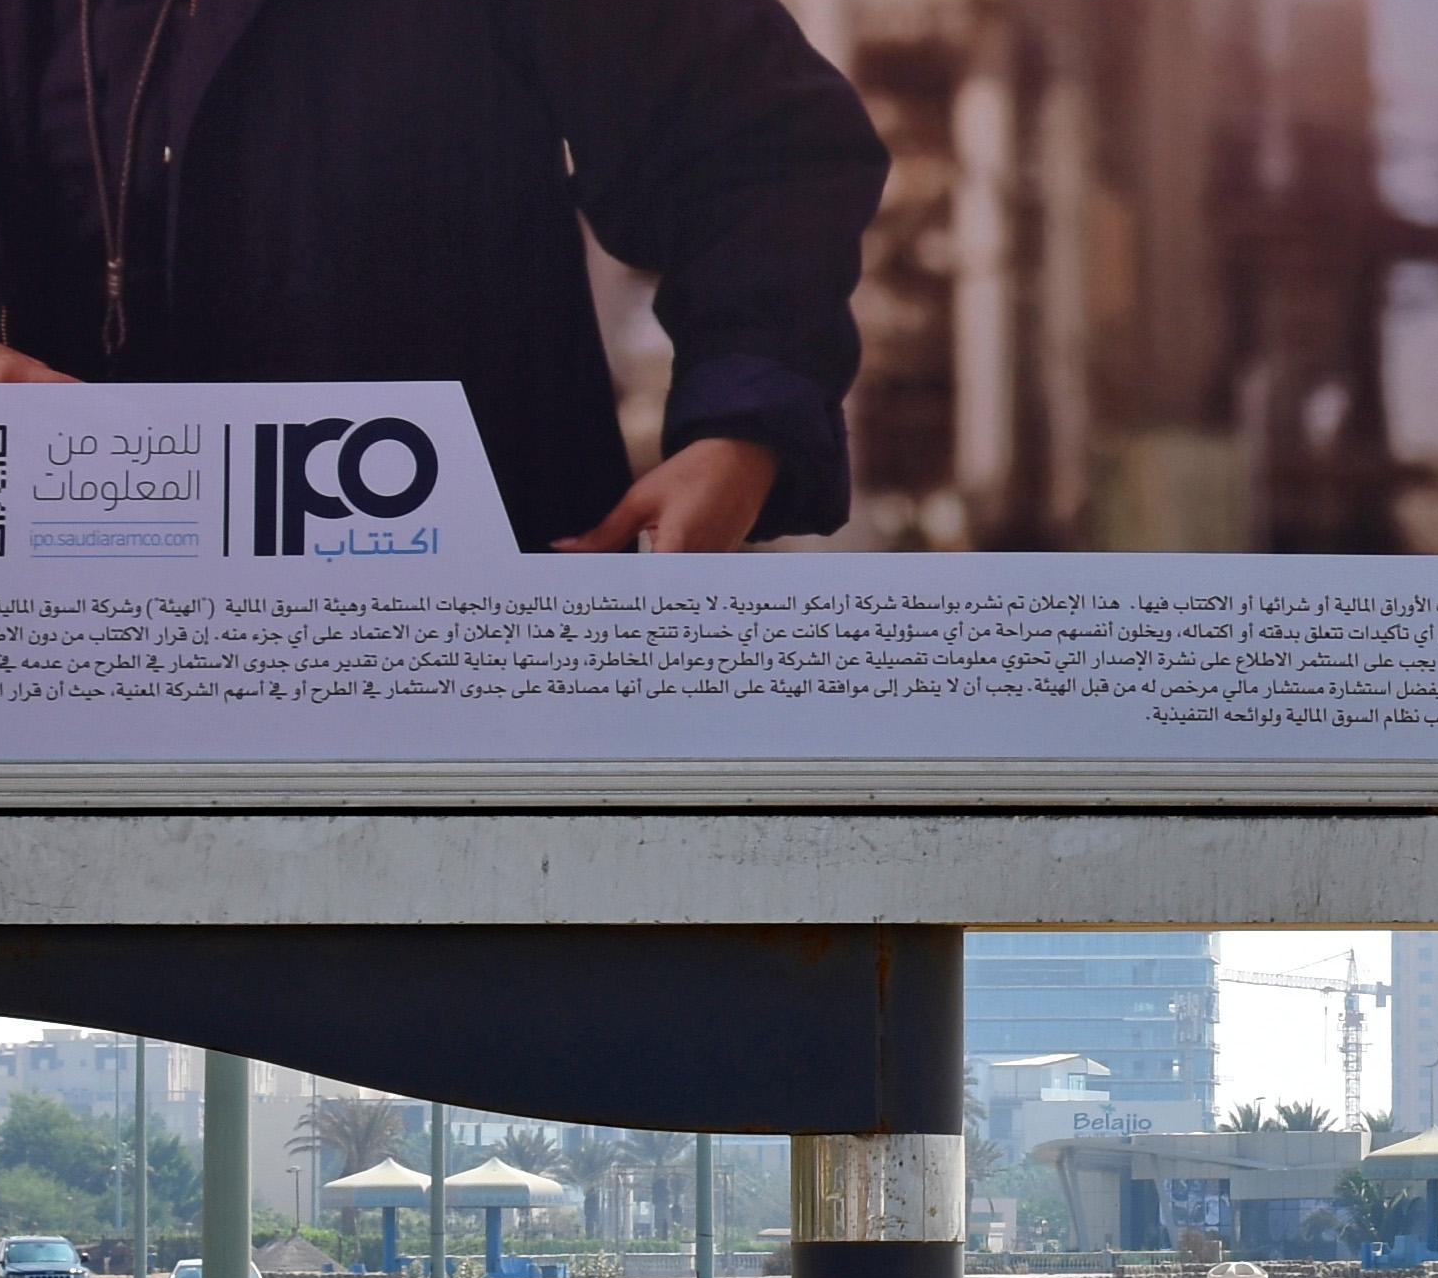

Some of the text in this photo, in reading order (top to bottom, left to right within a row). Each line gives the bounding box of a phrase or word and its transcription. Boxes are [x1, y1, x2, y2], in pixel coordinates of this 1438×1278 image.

[48, 423, 201, 466] للمزيد من
[33, 469, 200, 512] المعلومات
[29, 530, 200, 548] ipo.saudiaramco.com
[314, 527, 438, 563] اكتتاب
[38, 598, 87, 619] السوق
[90, 598, 143, 619] وشركة
[225, 597, 267, 618] المالية
[270, 597, 319, 619] السوق
[323, 597, 367, 618] وهيئة
[371, 596, 431, 613] المستلمة
[435, 595, 502, 616] والجهات
[504, 595, 558, 616] الماليون
[562, 595, 647, 616] المستشارون
[650, 595, 701, 616] يتحمل
[705, 594, 719, 611] لا
[722, 595, 797, 616] السعودية.
[800, 593, 851, 616] أرامكو
[854, 594, 898, 616] شركة
[901, 594, 961, 615] بواسطة
[964, 594, 1004, 615] نشره
[1006, 594, 1025, 618] تم
[1028, 593, 1086, 616] الإعلان
[1091, 594, 1121, 610] هذا
[1129, 594, 1169, 615] فيها.
[1172, 595, 1234, 615] الاكتتاب
[1237, 594, 1254, 616] أو
[1259, 595, 1311, 617] شرائها
[1313, 594, 1330, 617] أو
[1334, 596, 1376, 617] المالية
[1379, 594, 1432, 618] الأوراق
[20, 657, 63, 670] عدمه
[66, 658, 91, 674] من
[94, 653, 142, 678] الطرح
[145, 653, 166, 674] في
[167, 652, 239, 675] الاستثمار
[242, 658, 291, 674] جدوى
[294, 657, 330, 673] مدى
[332, 653, 378, 674] تقدير
[381, 656, 405, 672] من
[408, 651, 460, 672] للتمكن
[463, 651, 508, 671] بعناية
[512, 651, 579, 672] ودراستها
[657, 651, 715, 672] وعوامل
[717, 650, 774, 675] والطرح
[777, 650, 831, 672] الشركة
[835, 655, 861, 671] عن
[865, 650, 929, 670] تفصيلية
[931, 649, 998, 670] معلومات
[1001, 650, 1051, 674] تحتوي
[1054, 649, 1087, 674] التي
[1089, 649, 1153, 672] الإصدار
[1157, 651, 1197, 671] نشرة
[1199, 651, 1232, 672] على
[1235, 651, 1292, 675] الاطلاع
[1295, 651, 1359, 672] المستثمر
[1363, 652, 1395, 673] على
[1398, 659, 1437, 673] يجب
[7, 682, 43, 703] قرار
[45, 679, 65, 702] أن
[67, 684, 106, 702] حيث
[165, 681, 219, 702] الشركة
[223, 679, 265, 705] أسهم
[268, 680, 288, 701] في
[290, 679, 308, 702] أو
[310, 680, 358, 705] الطرح
[361, 679, 382, 700] في
[383, 678, 456, 700] الاستثمار
[459, 683, 508, 700] جدوى
[510, 678, 543, 700] على
[547, 678, 610, 695] مصادقة
[615, 677, 643, 698] أنها
[645, 679, 678, 700] على
[681, 678, 729, 699] الطلب
[733, 678, 766, 700] على
[769, 678, 813, 699] الهيئة
[817, 678, 870, 699] موافقة
[872, 677, 899, 699] إلى
[901, 677, 942, 699] ينظر
[946, 677, 960, 693] لا
[963, 675, 982, 697] أن
[985, 684, 1024, 697] يجب
[1026, 677, 1077, 697] الهيئة.
[1080, 677, 1110, 698] قبل
[1112, 682, 1137, 698] من
[1140, 678, 1157, 694] له
[1159, 679, 1219, 699] مرخص
[1222, 678, 1259, 703] مالي
[1261, 678, 1325, 700] مستشار
[1328, 679, 1392, 700] استشارة
[1073, 1112, 1152, 1135] Belajio
